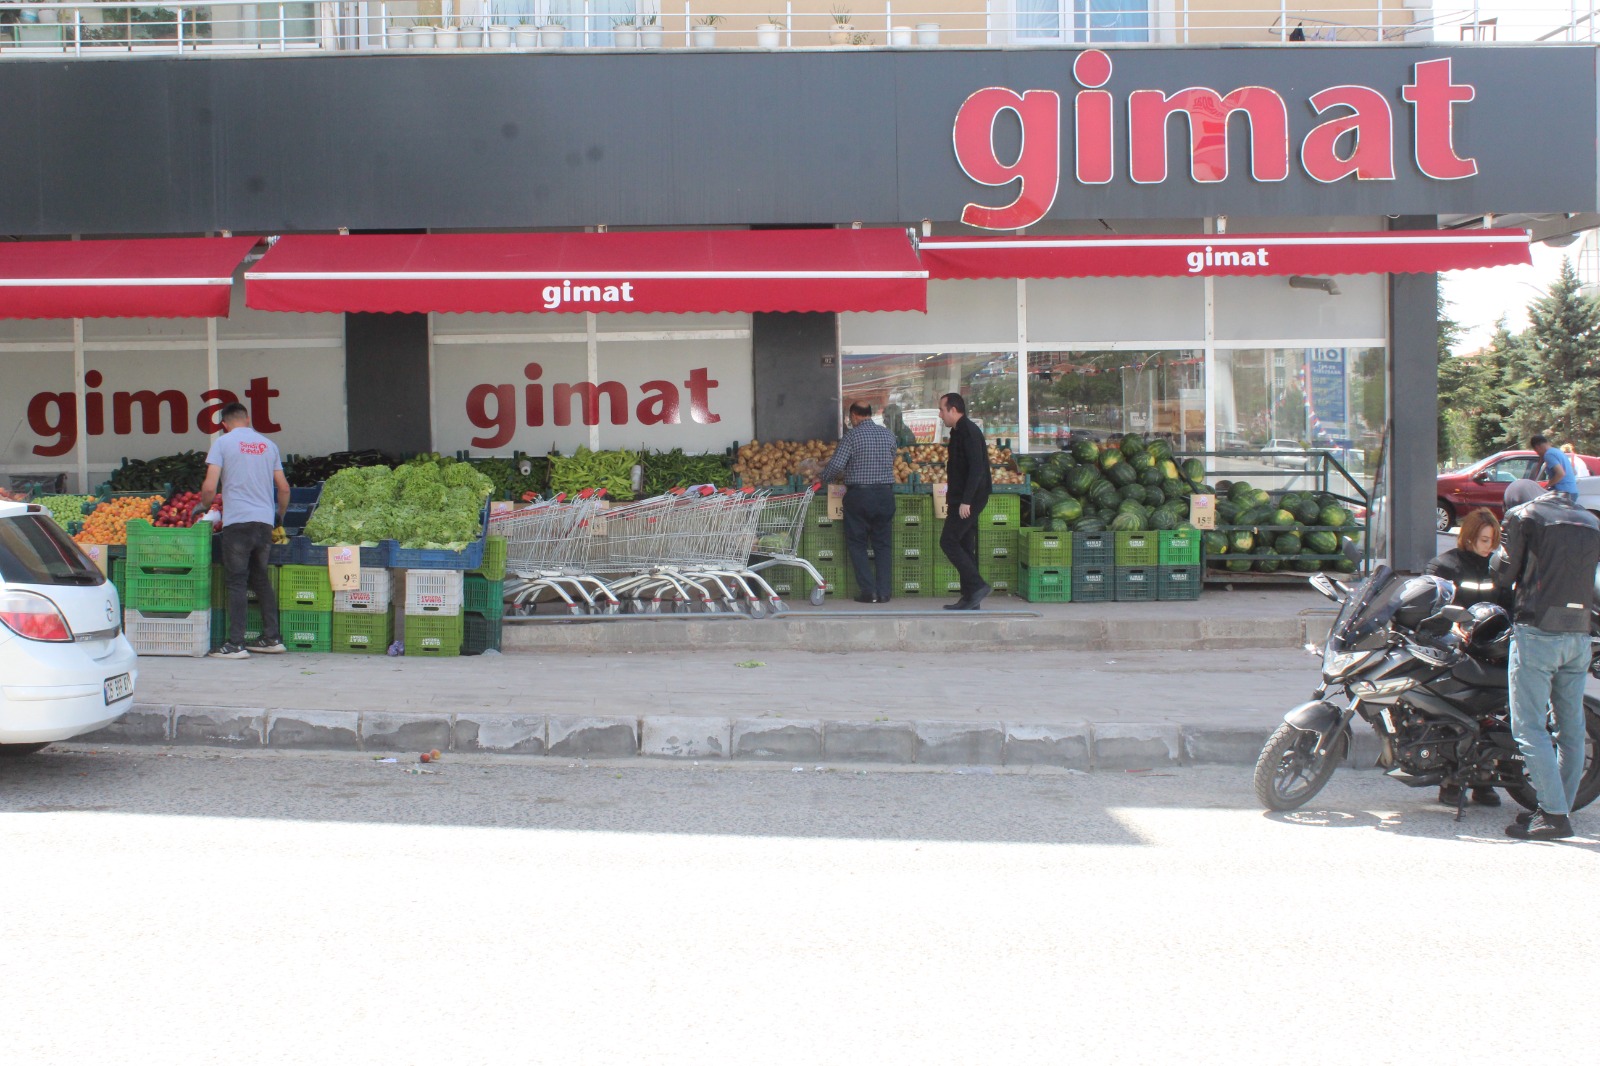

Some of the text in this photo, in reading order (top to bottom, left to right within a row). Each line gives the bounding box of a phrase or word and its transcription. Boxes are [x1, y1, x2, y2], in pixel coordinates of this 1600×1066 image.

[953, 49, 1478, 231] gimat
[1187, 246, 1269, 272] gimat
[542, 279, 634, 309] gimat
[28, 370, 282, 457] gimat
[466, 362, 721, 449] gimat
[343, 573, 350, 583] 9
